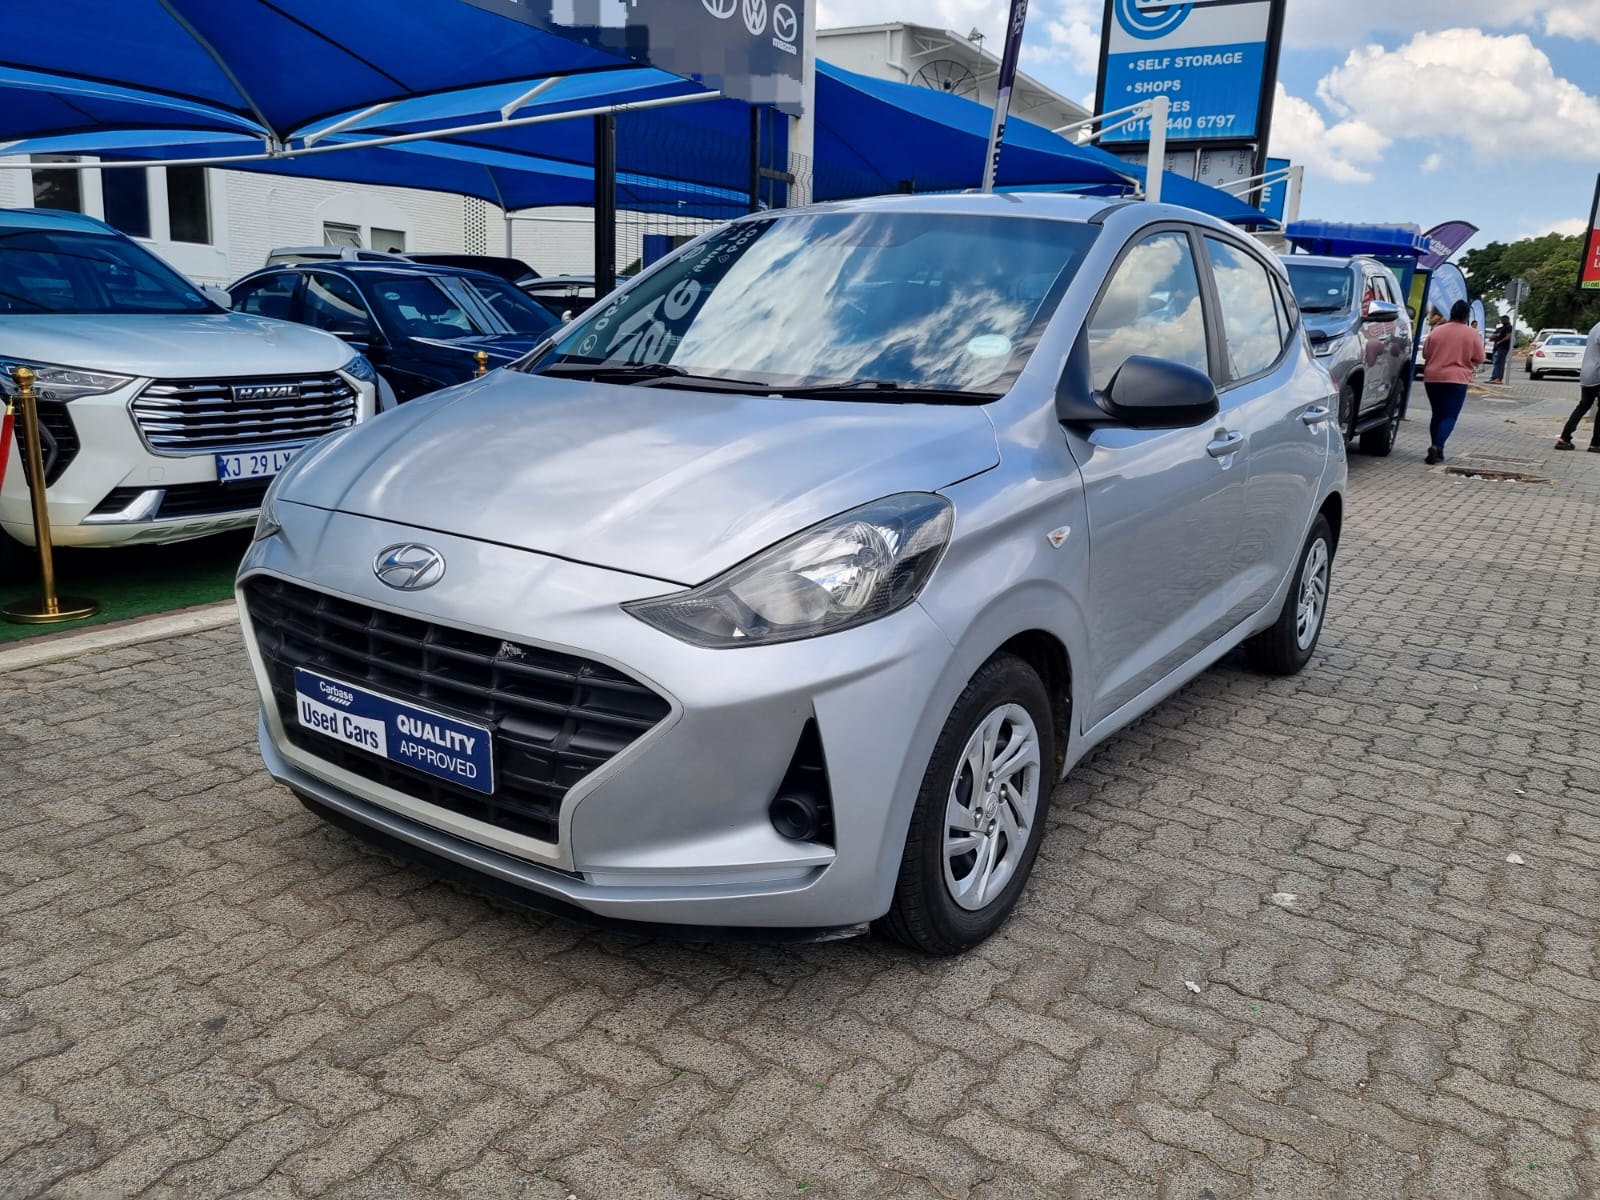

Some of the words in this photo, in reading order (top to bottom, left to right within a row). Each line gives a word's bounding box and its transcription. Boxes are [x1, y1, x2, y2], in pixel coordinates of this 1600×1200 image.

[1136, 58, 1171, 71] SELF
[1174, 52, 1243, 68] STORAGE
[1134, 80, 1182, 93] SHOPS
[1197, 114, 1236, 128] 6797
[239, 386, 298, 399] HAVAL
[250, 455, 268, 474] 29
[319, 681, 354, 702] Carbase
[302, 701, 339, 734] Used
[342, 716, 379, 749] Cars
[396, 714, 476, 755] QUALITY
[400, 740, 477, 779] APPROVED
